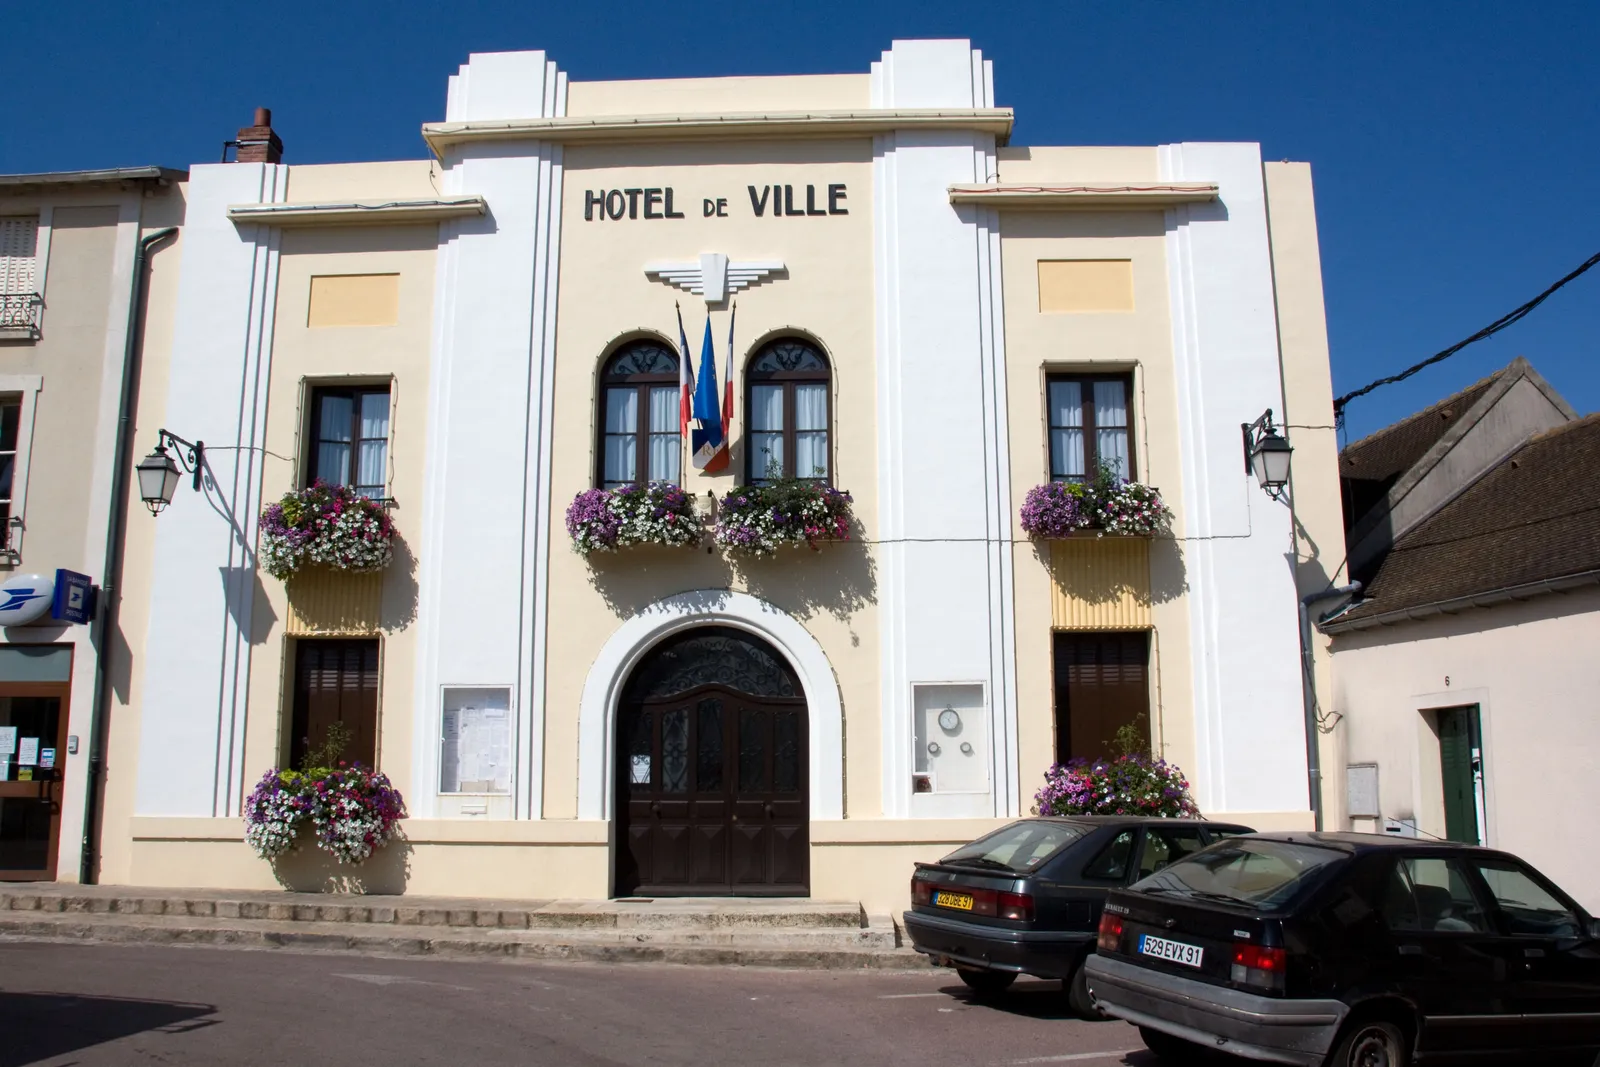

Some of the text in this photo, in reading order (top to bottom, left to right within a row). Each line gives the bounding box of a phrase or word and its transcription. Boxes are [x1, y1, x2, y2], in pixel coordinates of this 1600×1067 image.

[584, 184, 849, 221] HOTEL DE VILLE
[1445, 676, 1450, 687] 6
[962, 895, 973, 908] 91
[1145, 937, 1200, 965] 529 EVX 91
